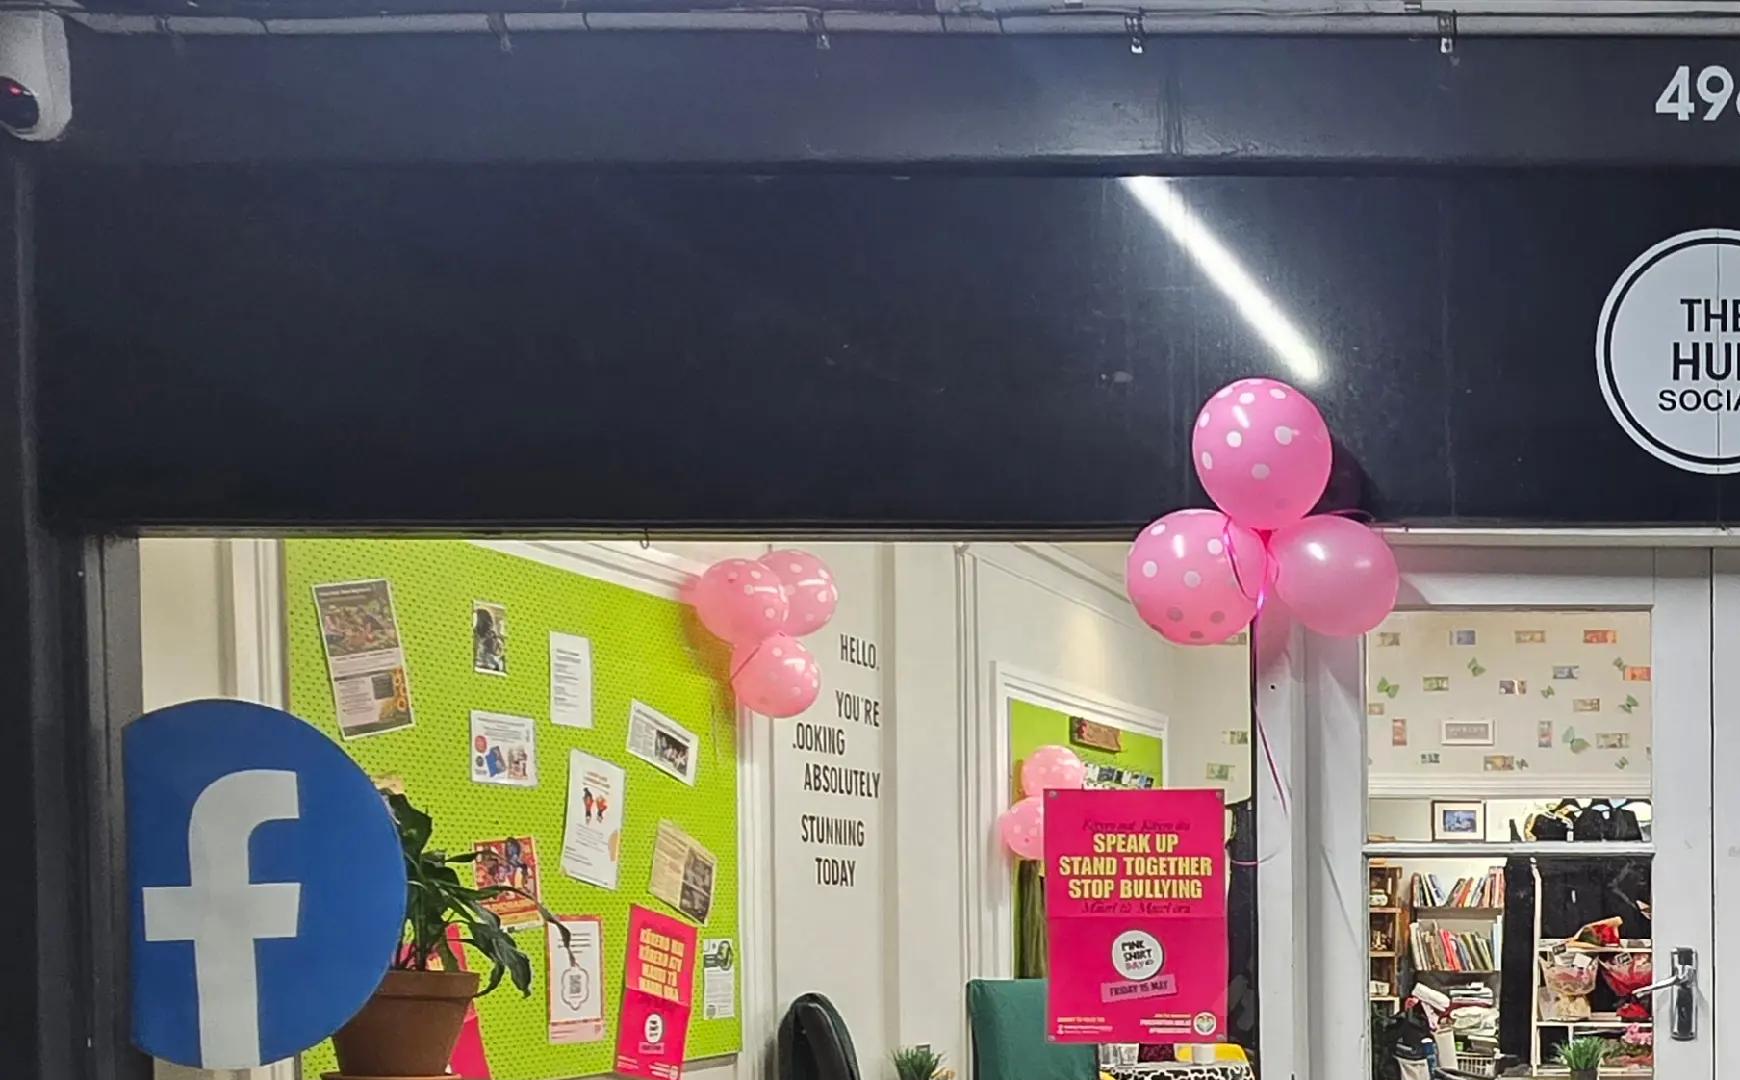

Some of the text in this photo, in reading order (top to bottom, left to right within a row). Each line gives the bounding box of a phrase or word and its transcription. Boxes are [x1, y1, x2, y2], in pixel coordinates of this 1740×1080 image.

[834, 689, 880, 728] YOU'RE
[792, 722, 846, 756] OOKING
[803, 762, 881, 799] ABSOLUTELY
[801, 813, 865, 847] STUNNING
[1093, 833, 1179, 854] SPEAK UP
[815, 857, 856, 887] TODAY
[1059, 856, 1213, 877] STAND TOGETHER
[1068, 879, 1203, 900] STOP BULLYING
[1121, 940, 1145, 951] PINK
[1123, 949, 1153, 962] SHIRT
